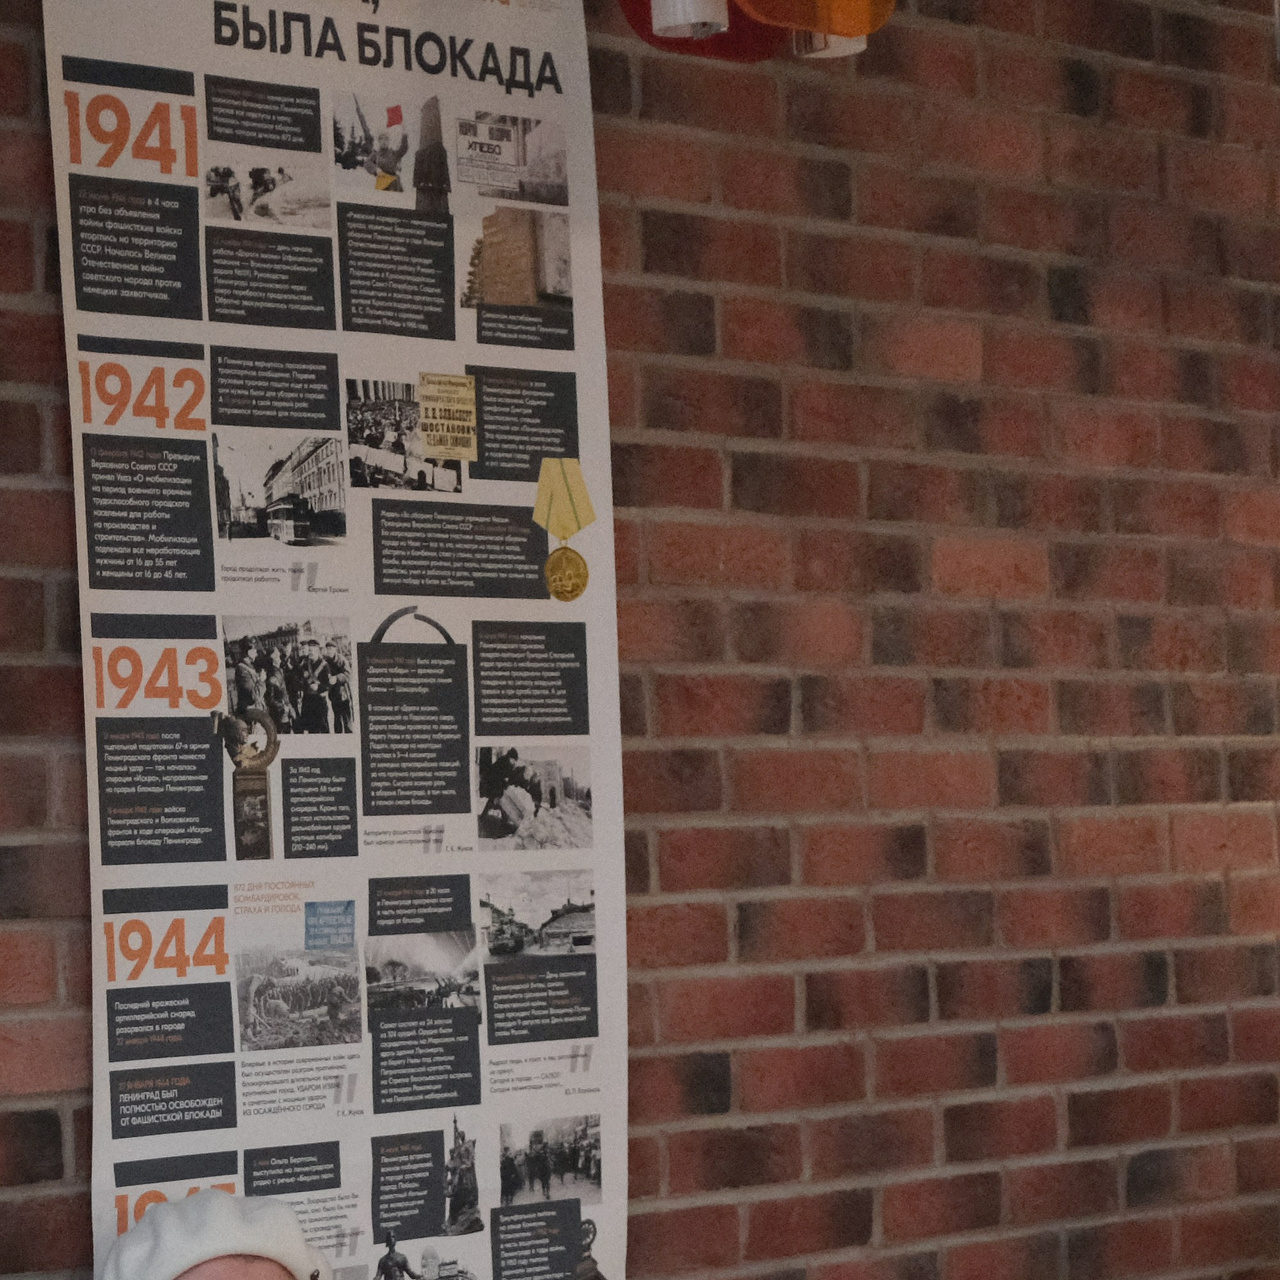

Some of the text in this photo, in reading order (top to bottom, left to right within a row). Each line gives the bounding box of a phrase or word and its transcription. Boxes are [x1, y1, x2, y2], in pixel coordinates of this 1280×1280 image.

[214, 0, 564, 98] БЫЛА БЛОКАДА
[63, 89, 199, 178] 1941
[78, 360, 207, 431] 1942
[92, 645, 223, 710] 1943
[104, 916, 230, 982] 1944
